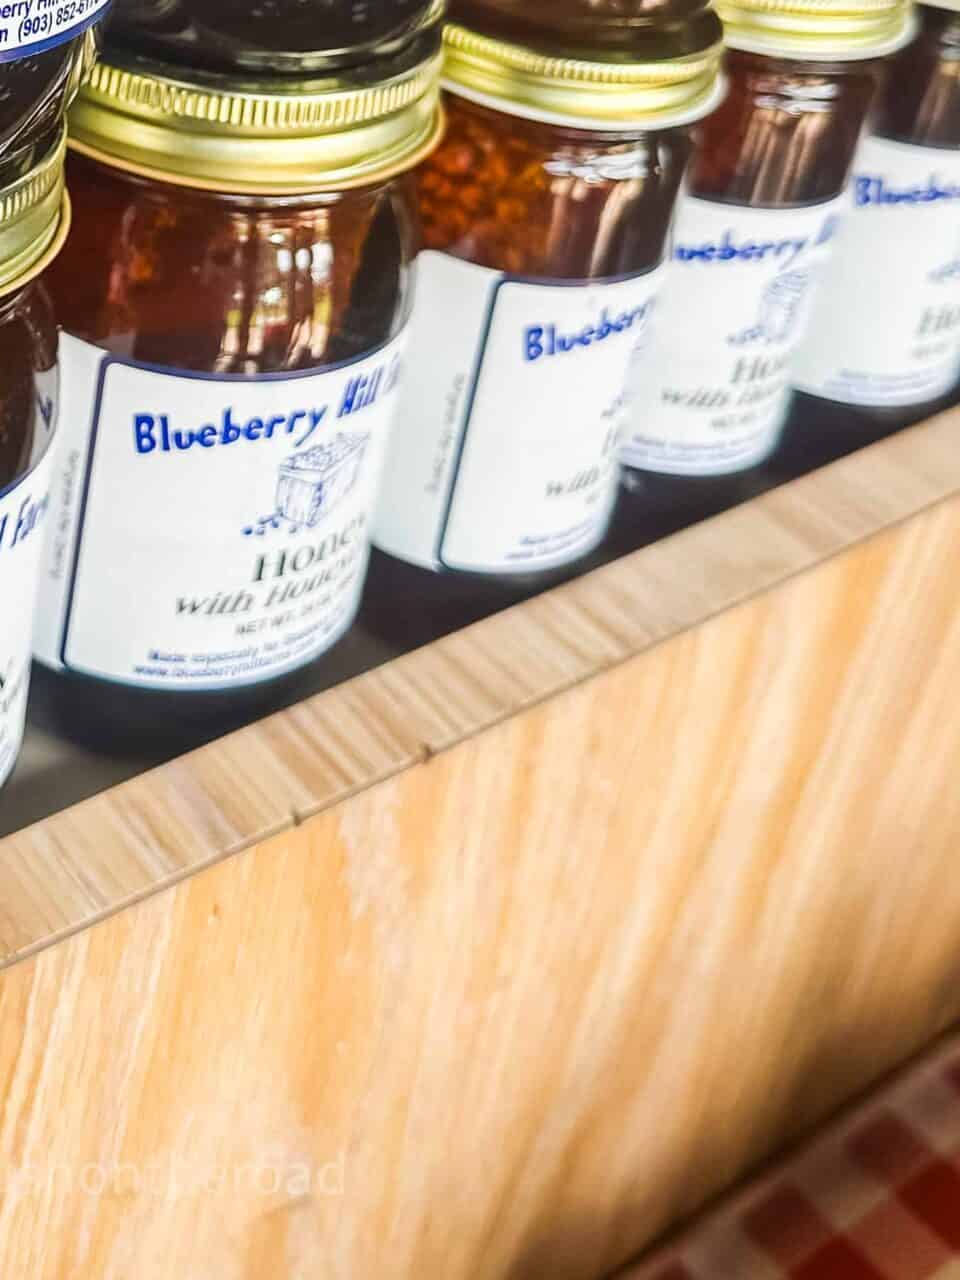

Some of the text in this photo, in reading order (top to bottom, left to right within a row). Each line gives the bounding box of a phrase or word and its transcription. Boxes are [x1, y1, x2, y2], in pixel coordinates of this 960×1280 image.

[18, 13, 53, 43] (903)
[133, 406, 328, 455] Blueberry
[176, 589, 254, 616] with
